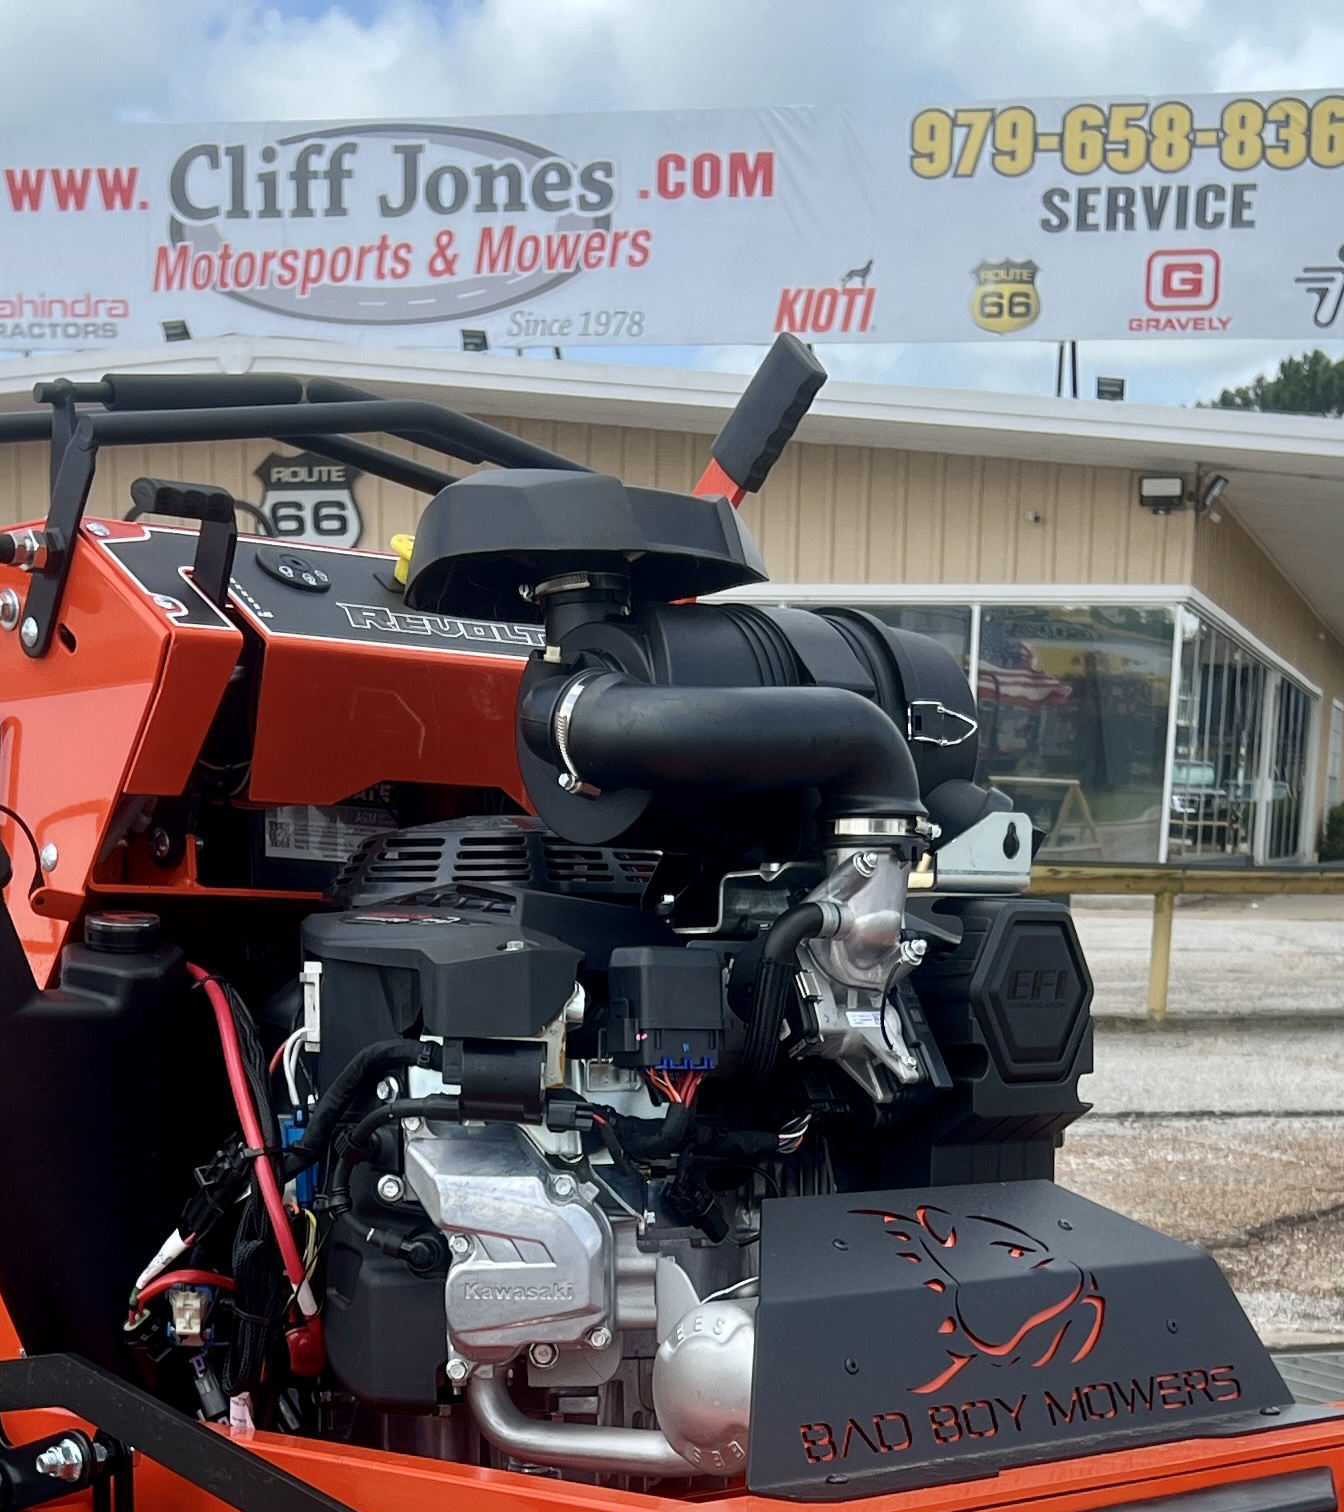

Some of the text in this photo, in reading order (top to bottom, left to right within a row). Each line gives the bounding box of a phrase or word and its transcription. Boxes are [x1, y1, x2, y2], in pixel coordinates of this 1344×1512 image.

[169, 142, 356, 219] Cliff
[378, 143, 616, 218] Jones
[638, 150, 775, 200] .COM
[1040, 184, 1259, 233] SERVICE
[152, 225, 652, 297] Motorsports & Mowers
[980, 268, 1033, 281] ROUTE
[773, 287, 877, 333] KIOTI
[981, 291, 1031, 318] 66
[507, 310, 646, 337] Since 1978
[1129, 317, 1233, 332] GRAVELY
[270, 466, 347, 483] ROUTE
[271, 501, 348, 537] 66
[1007, 970, 1070, 1001] EFI
[464, 1281, 574, 1301] Kawasaki
[799, 1364, 1242, 1464] BAD BOY MOWERS
